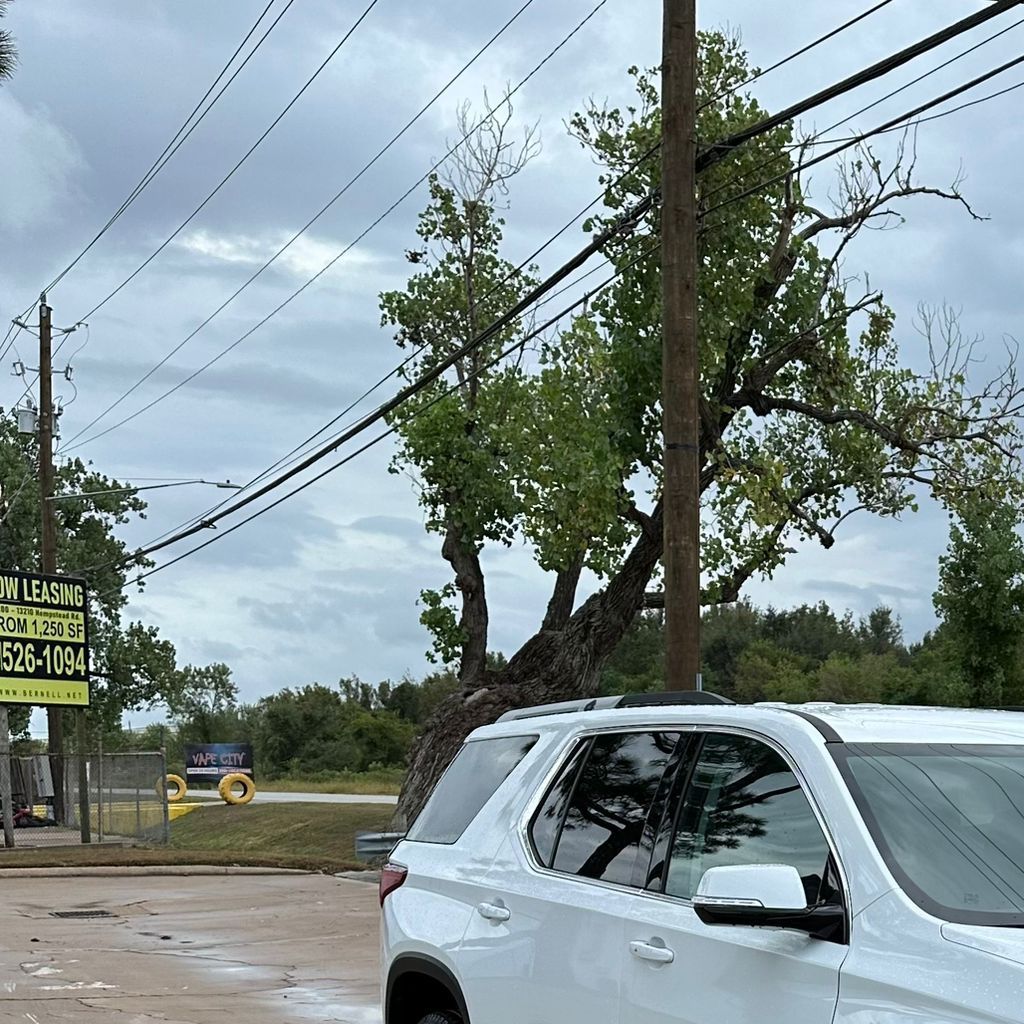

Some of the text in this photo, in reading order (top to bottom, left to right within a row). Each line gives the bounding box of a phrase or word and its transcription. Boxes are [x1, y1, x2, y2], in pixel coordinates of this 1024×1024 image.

[23, 578, 84, 607] LEASING
[16, 607, 33, 616] 13210
[35, 610, 69, 620] Hempstead
[71, 612, 81, 620] Rd.
[32, 619, 64, 637] 1,250
[68, 622, 83, 639] SF
[0, 641, 86, 676] 526-1094
[192, 752, 246, 766] VAPE CITY
